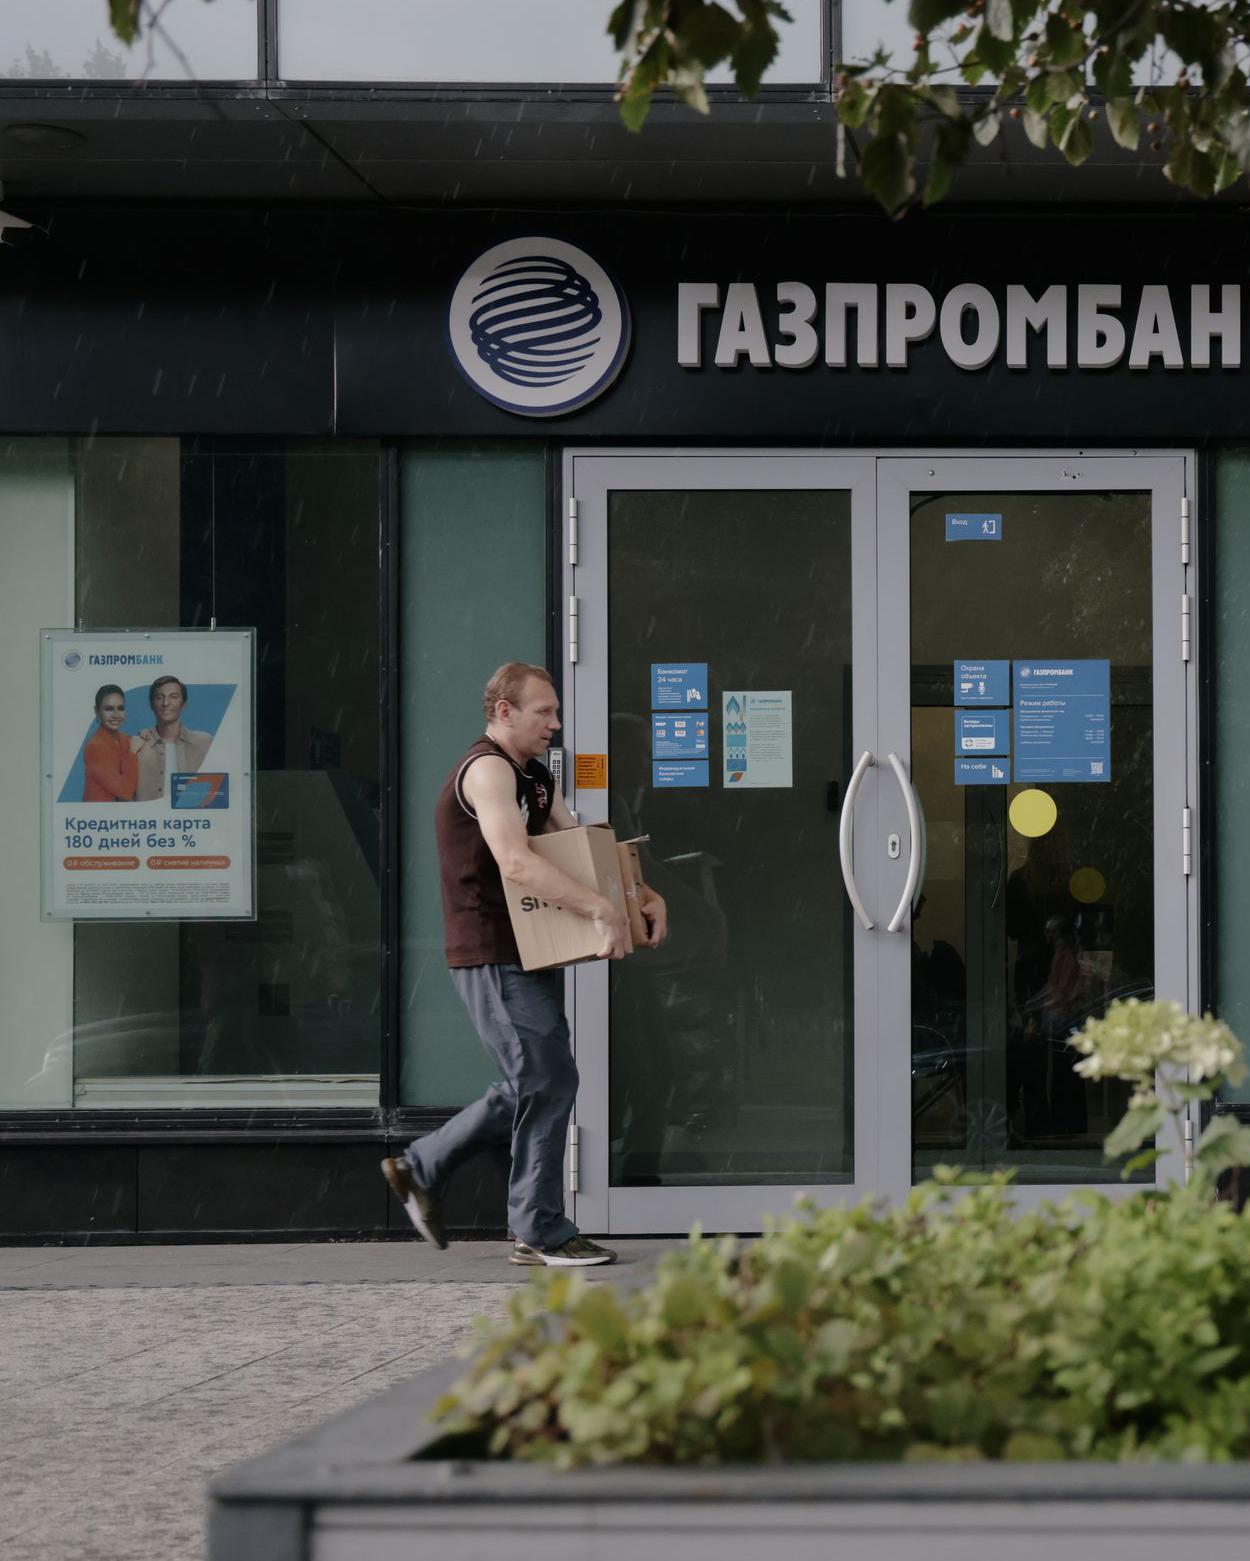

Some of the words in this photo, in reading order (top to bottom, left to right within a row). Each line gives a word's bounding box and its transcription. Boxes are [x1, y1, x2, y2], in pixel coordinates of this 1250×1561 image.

[88, 654, 164, 666] ГАЗПРОМБАНК
[1033, 668, 1074, 676] ГАЗПРОМБАНК
[65, 816, 157, 834] Кредитная
[163, 817, 211, 834] карта
[64, 832, 93, 849] 180
[98, 831, 141, 850] дней
[146, 832, 176, 848] без
[182, 833, 197, 848] %
